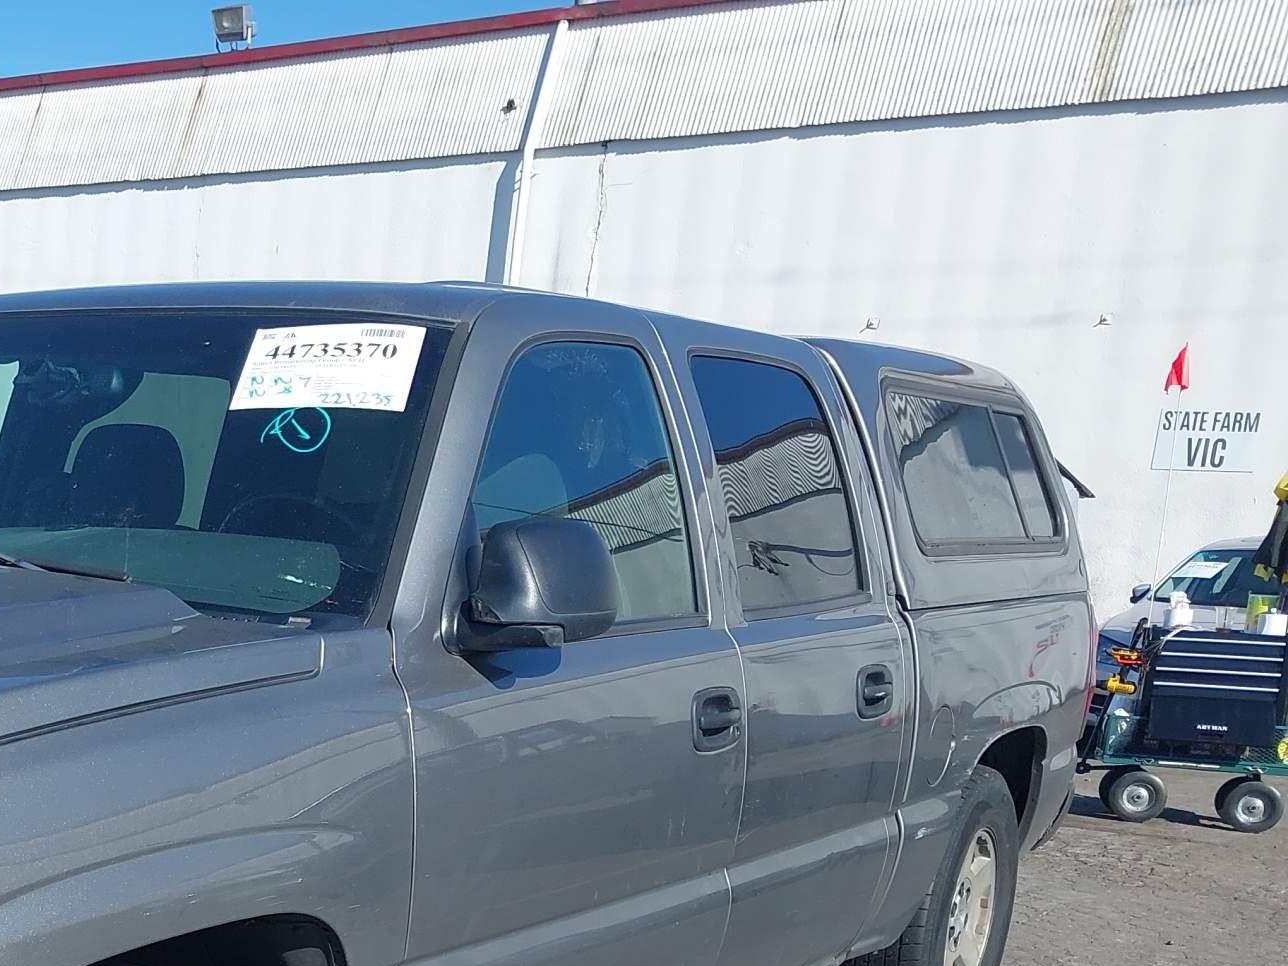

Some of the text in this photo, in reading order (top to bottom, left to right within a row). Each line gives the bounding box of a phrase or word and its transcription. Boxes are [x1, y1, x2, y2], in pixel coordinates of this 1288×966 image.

[265, 342, 398, 360] 44735370
[1162, 410, 1261, 433] STATE FARM
[1186, 437, 1227, 468] VIC
